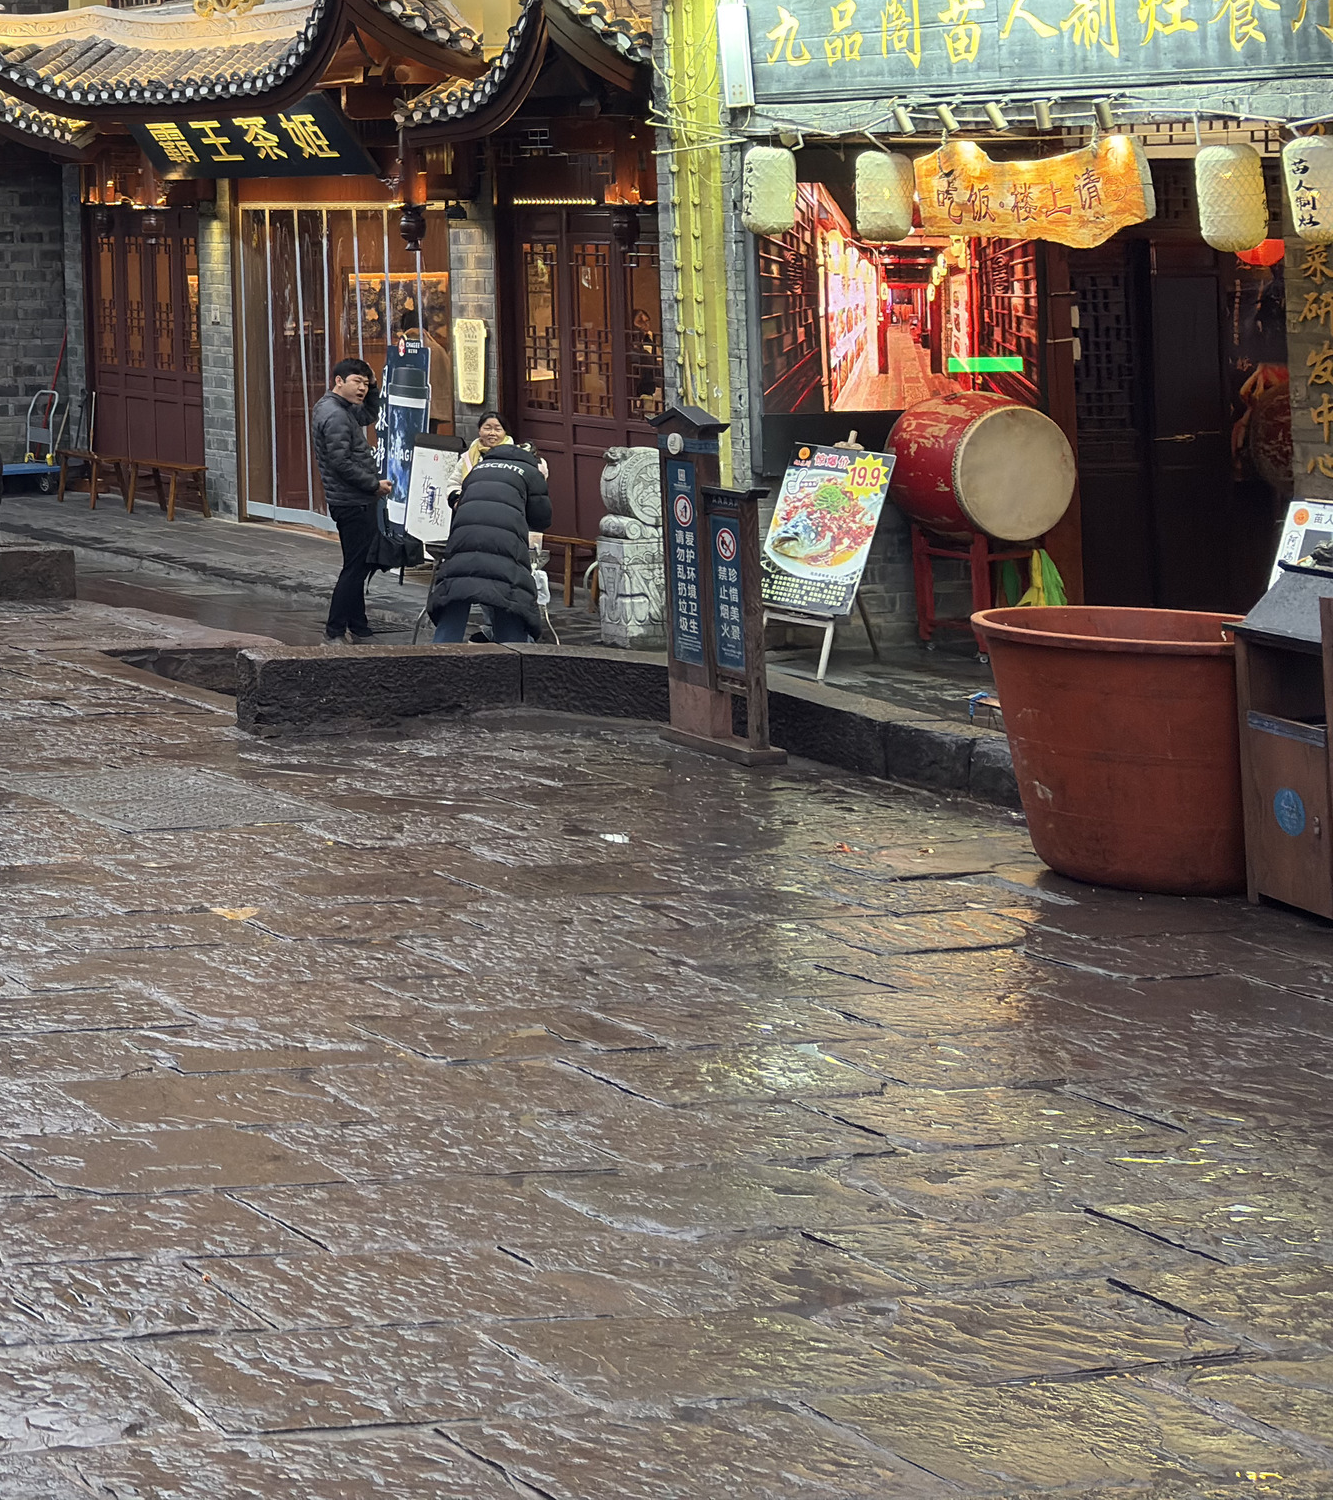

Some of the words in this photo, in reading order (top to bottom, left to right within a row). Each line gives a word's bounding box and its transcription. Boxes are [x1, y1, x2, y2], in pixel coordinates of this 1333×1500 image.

[145, 113, 341, 163] 霸王茶姬
[1290, 157, 1321, 228] 苗人制灶
[849, 466, 881, 487] 19.9
[675, 529, 689, 633] 请勿乱扔垃圾
[685, 530, 699, 635] 爱护环境卫生
[718, 565, 731, 639] 禁止烟火
[728, 566, 741, 641] 珍惜美景
